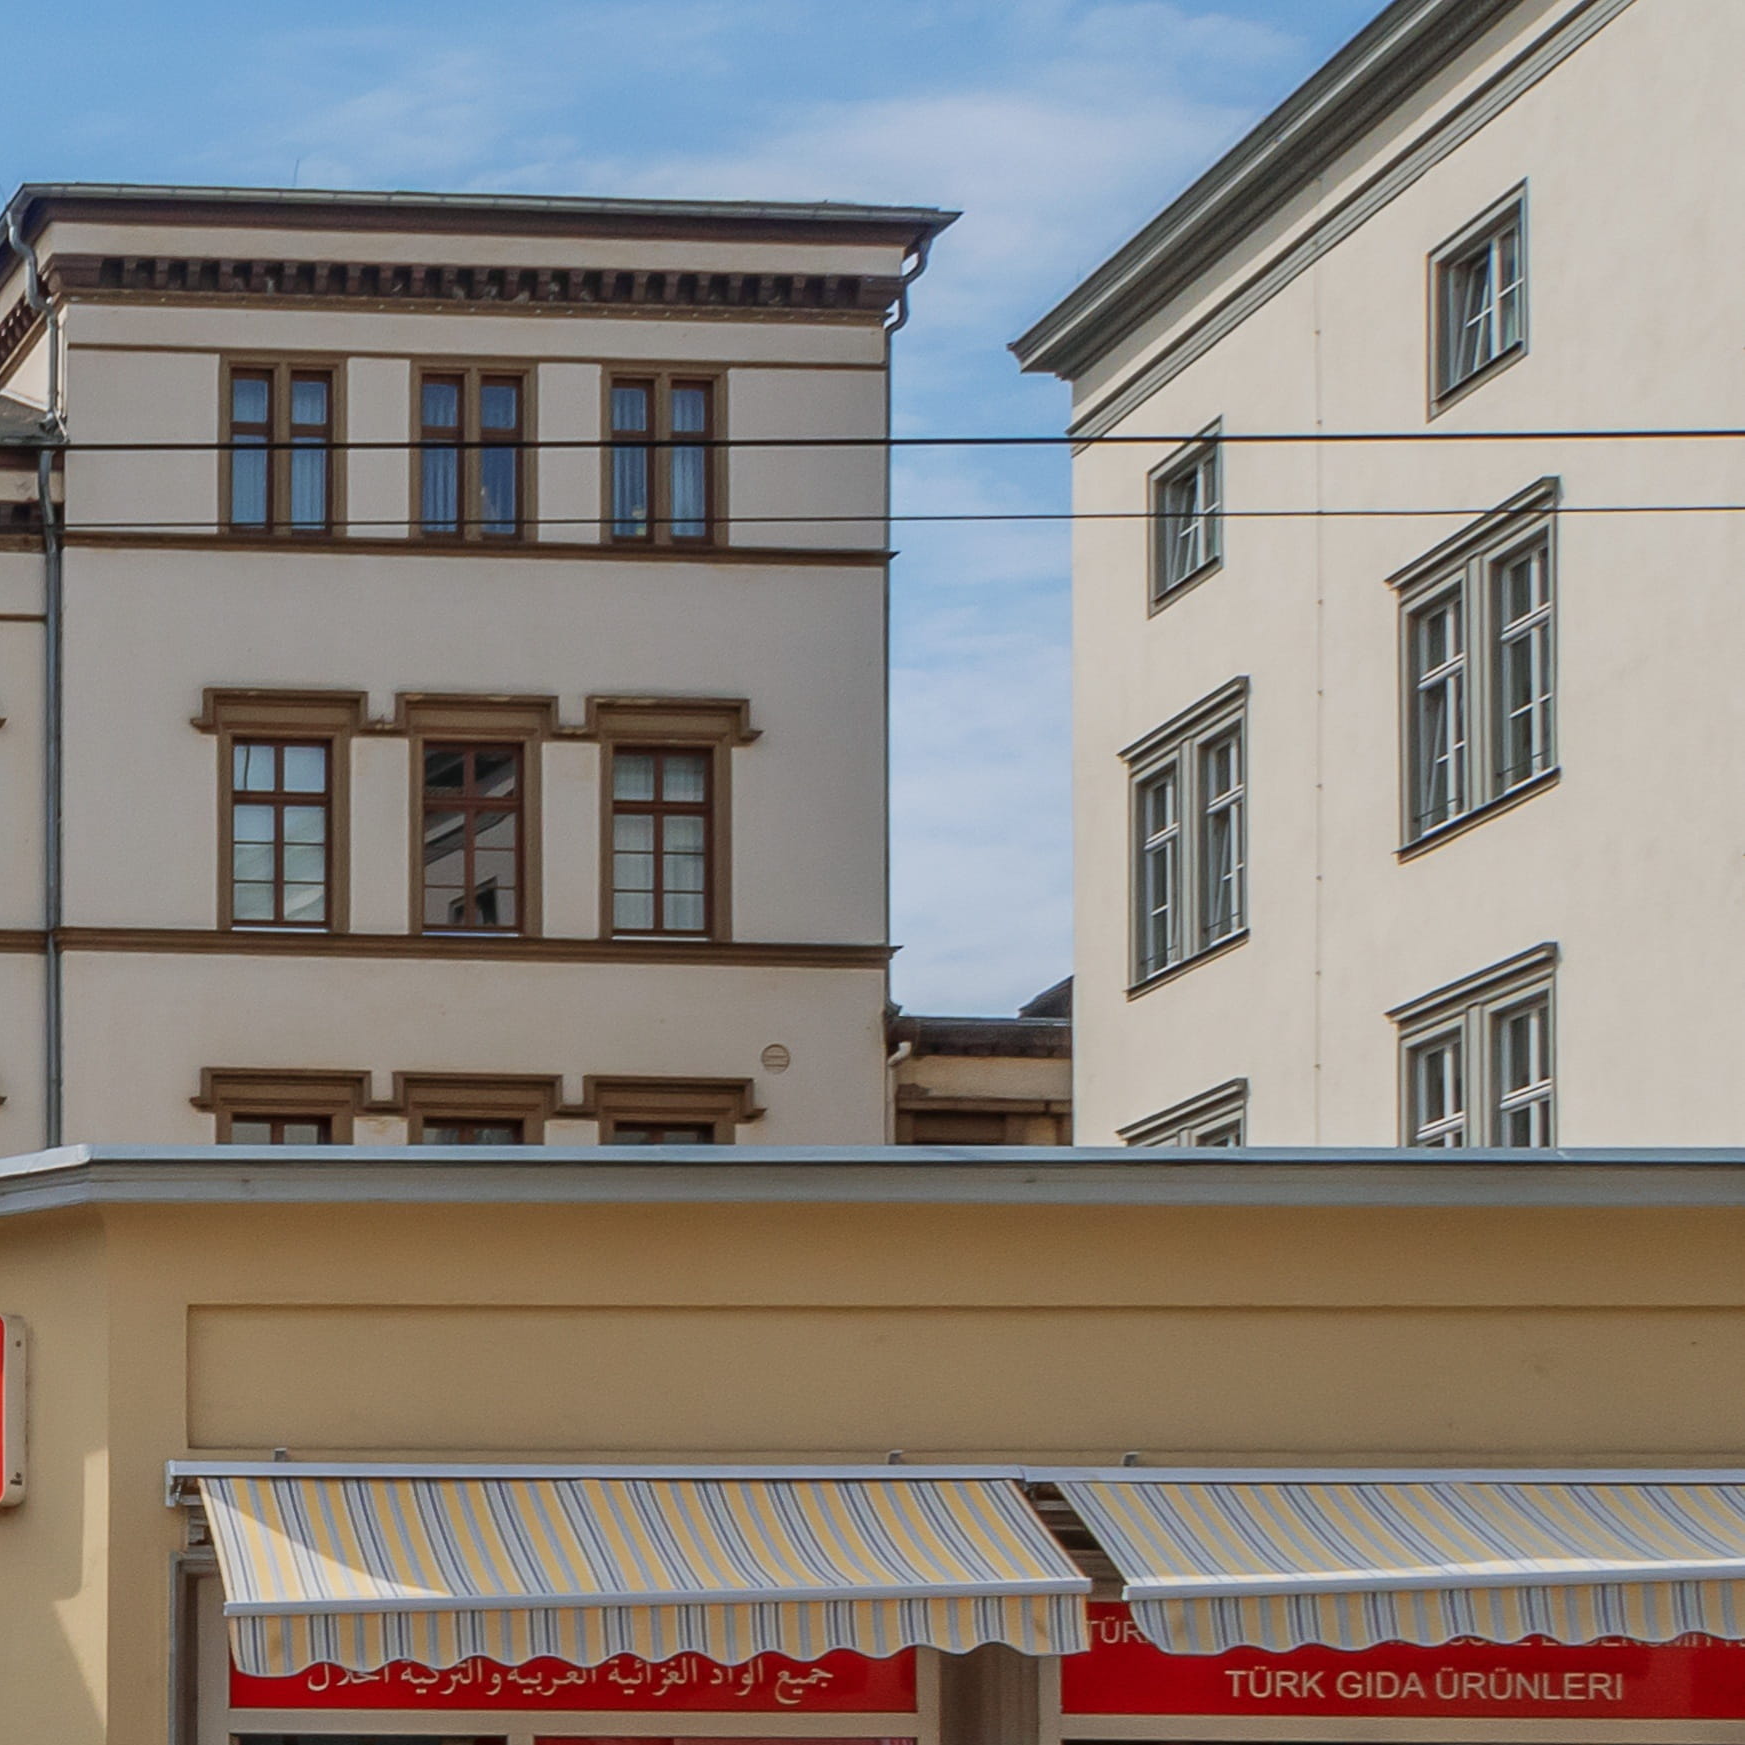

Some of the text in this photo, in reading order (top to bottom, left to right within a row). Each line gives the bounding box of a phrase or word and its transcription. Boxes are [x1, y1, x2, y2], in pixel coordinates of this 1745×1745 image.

[774, 1667, 834, 1704] جميع
[1225, 1665, 1624, 1700] TÜRK GIDA ÜRÜNLERI
